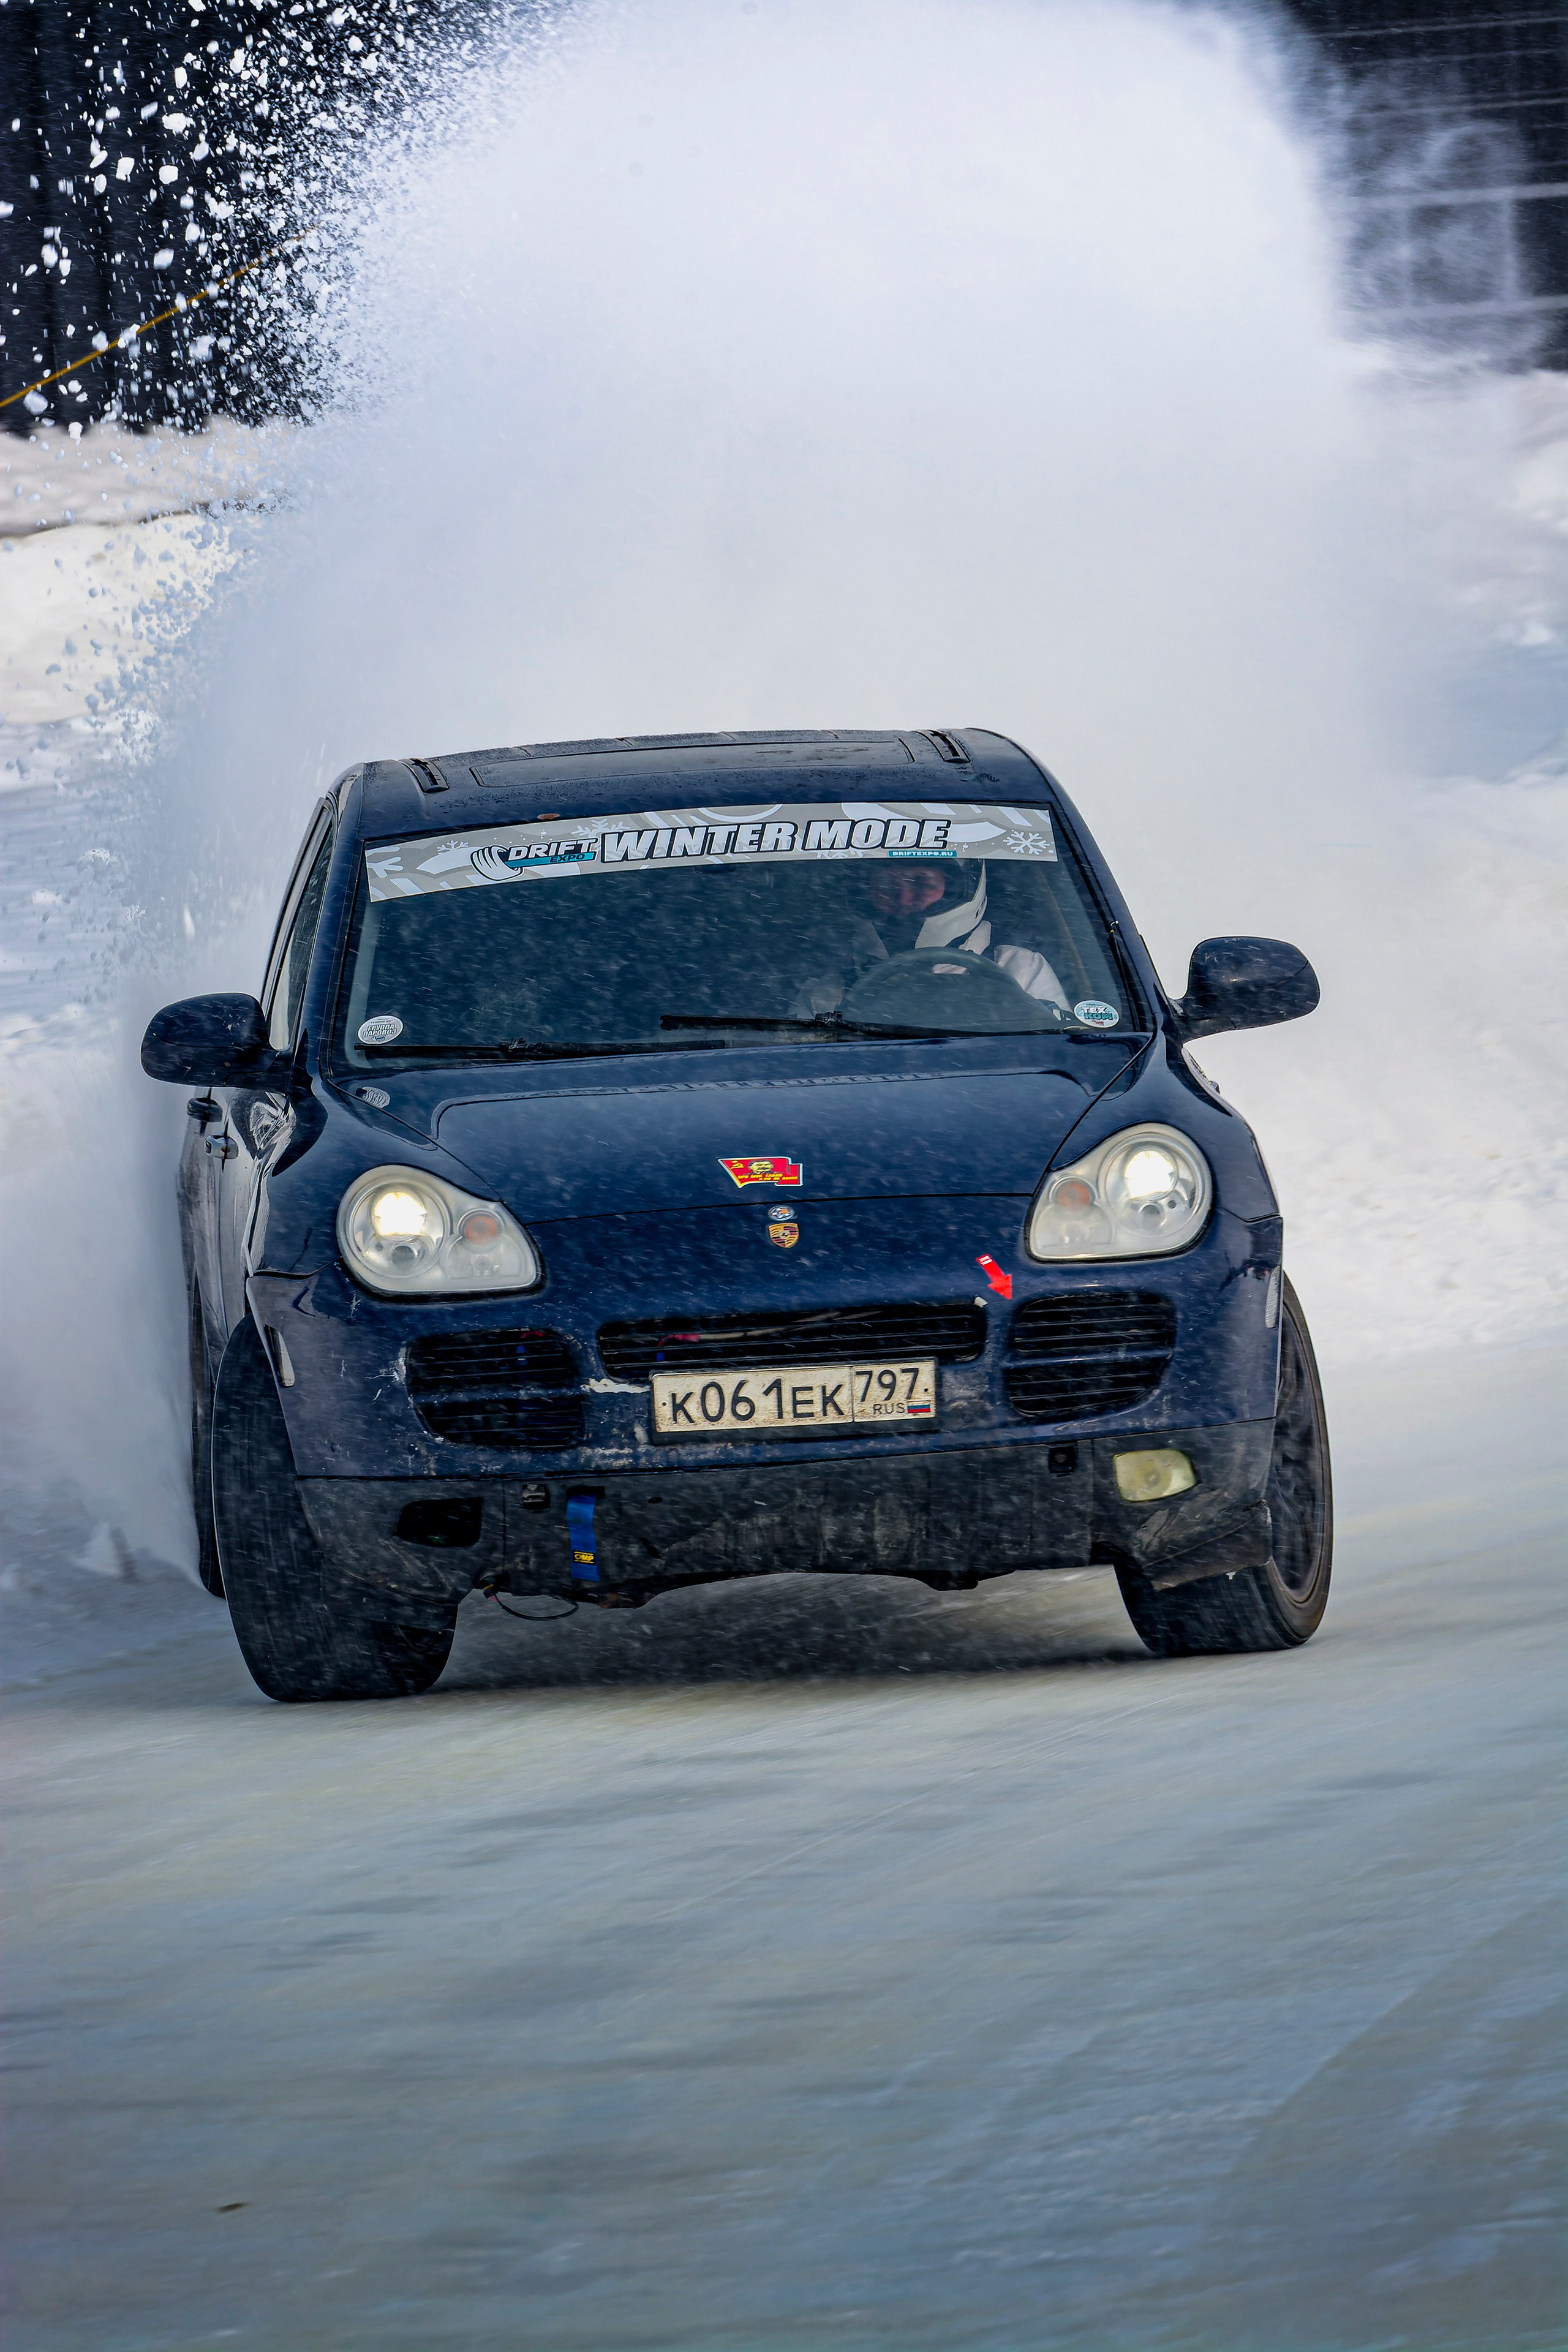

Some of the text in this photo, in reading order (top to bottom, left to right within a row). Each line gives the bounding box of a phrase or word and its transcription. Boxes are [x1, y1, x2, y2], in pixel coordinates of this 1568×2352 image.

[508, 839, 597, 861] DRIFT
[602, 820, 951, 862] WINTER MODE
[550, 854, 585, 862] EXPO
[856, 1367, 919, 1402] 797
[873, 1402, 905, 1415] RUS
